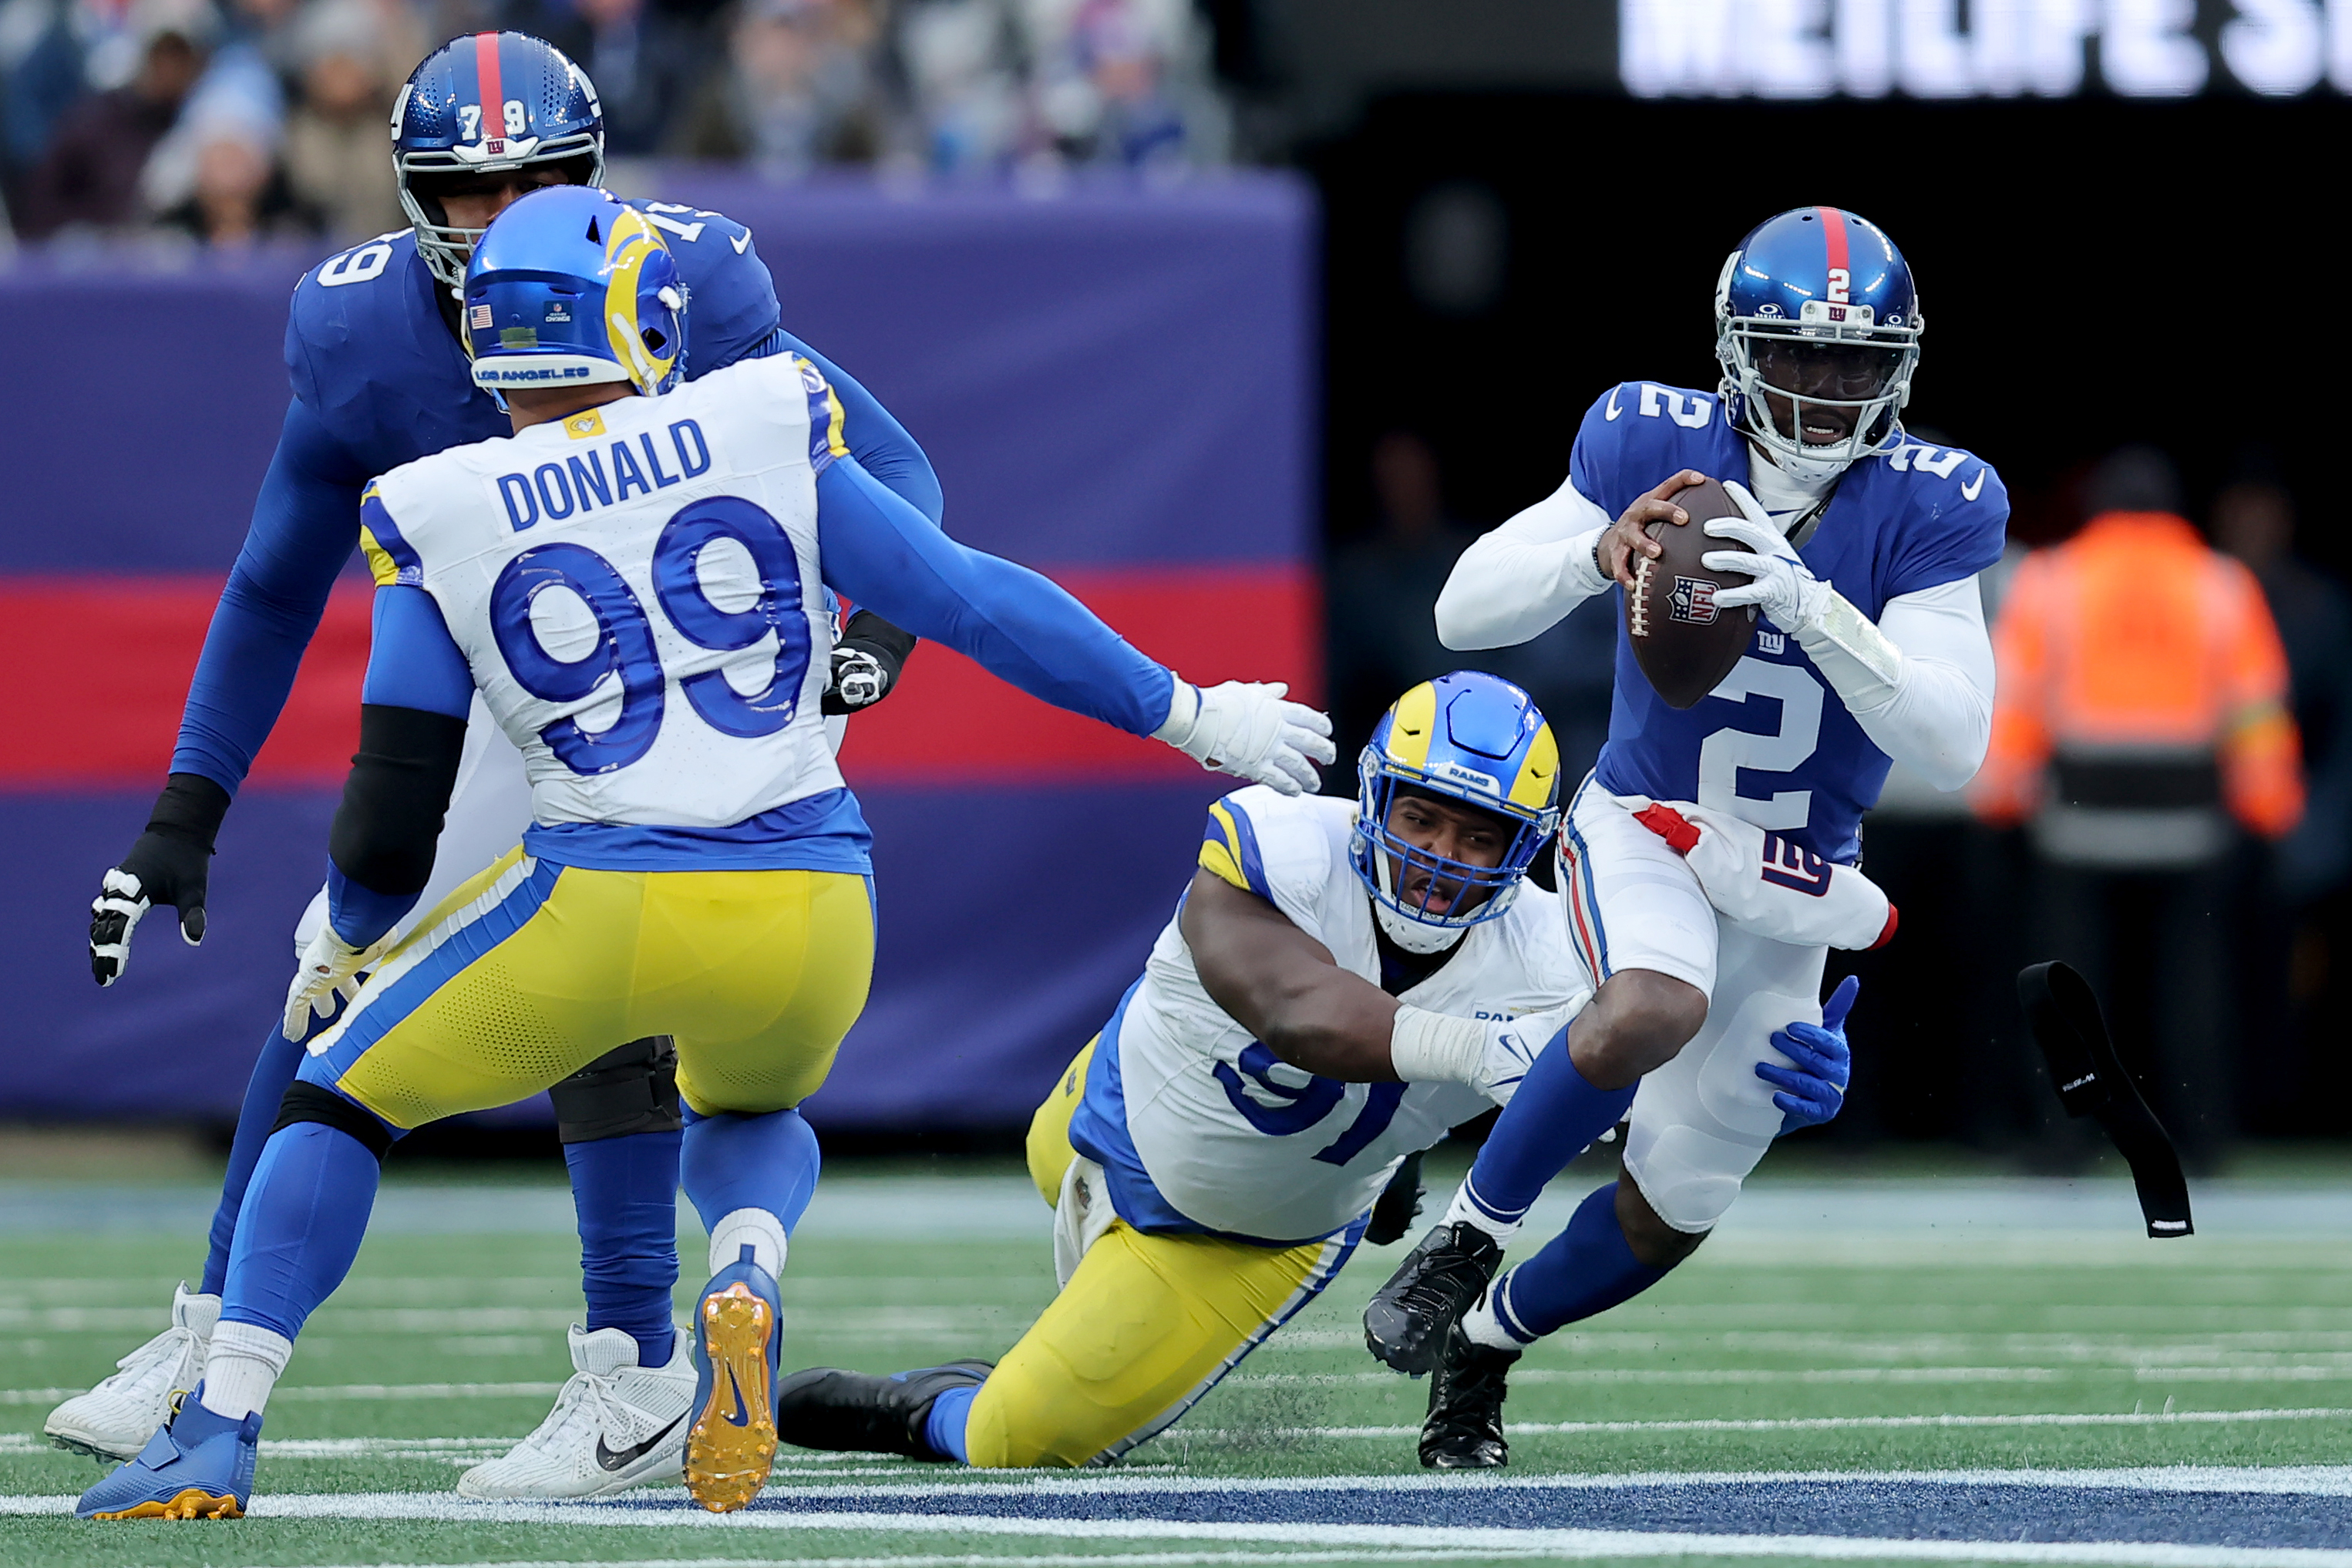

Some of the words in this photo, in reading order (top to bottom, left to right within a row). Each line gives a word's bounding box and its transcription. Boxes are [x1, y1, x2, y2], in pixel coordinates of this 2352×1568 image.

[2217, 0, 2352, 98] S
[1827, 268, 1850, 303] 2
[475, 370, 500, 381] LOS
[502, 367, 590, 382] ANGELES
[1639, 382, 1712, 429] 2
[496, 418, 712, 533] DONALD
[1889, 443, 1970, 479] 2
[1691, 586, 1715, 620] NFL
[489, 495, 813, 776] 99
[1698, 654, 1825, 831] 2
[1449, 767, 1489, 787] RAMS
